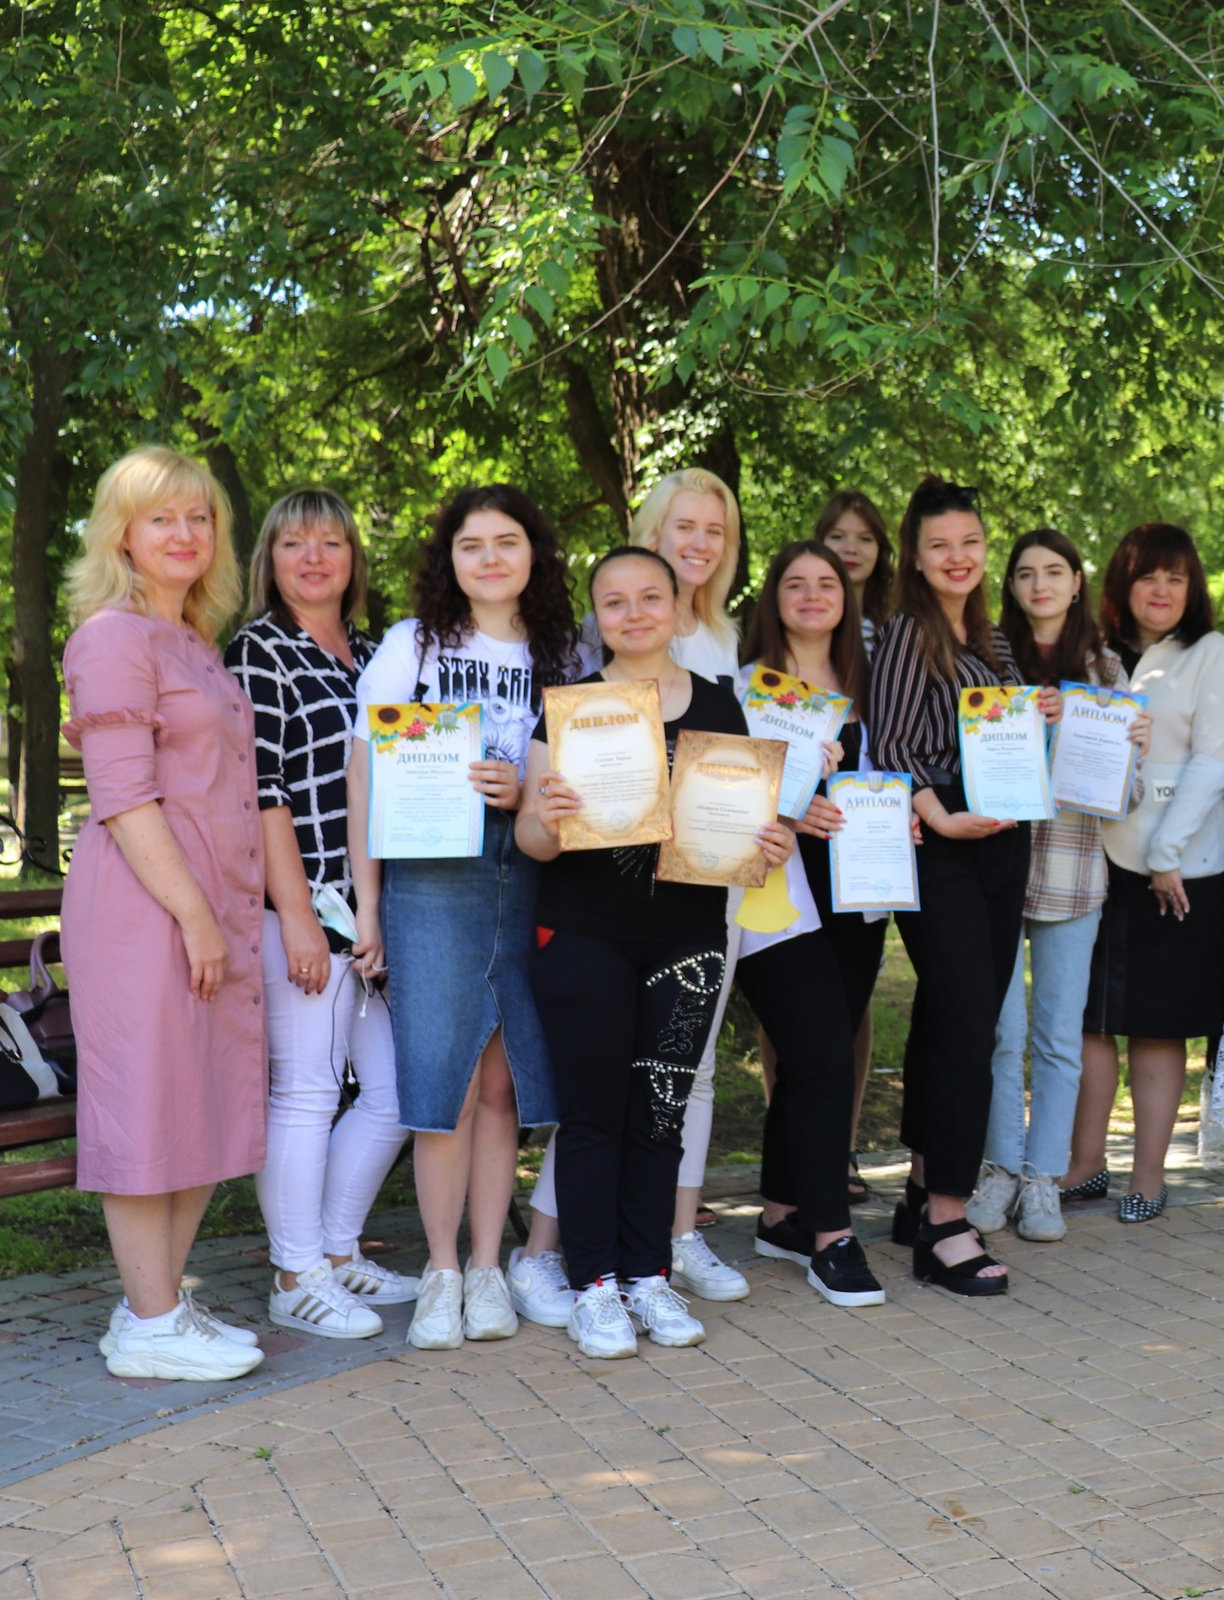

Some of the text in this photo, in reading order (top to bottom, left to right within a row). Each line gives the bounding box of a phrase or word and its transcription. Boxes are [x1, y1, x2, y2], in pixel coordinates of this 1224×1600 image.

[569, 712, 640, 731] ДИПЛОМ
[1071, 705, 1127, 726] ДИПЛОМ
[760, 713, 815, 740] ДИПЛОМ
[980, 732, 1028, 743] ДИПЛОМ
[396, 752, 460, 765] ДИПЛОМ
[845, 796, 902, 811] ДИПЛОМ
